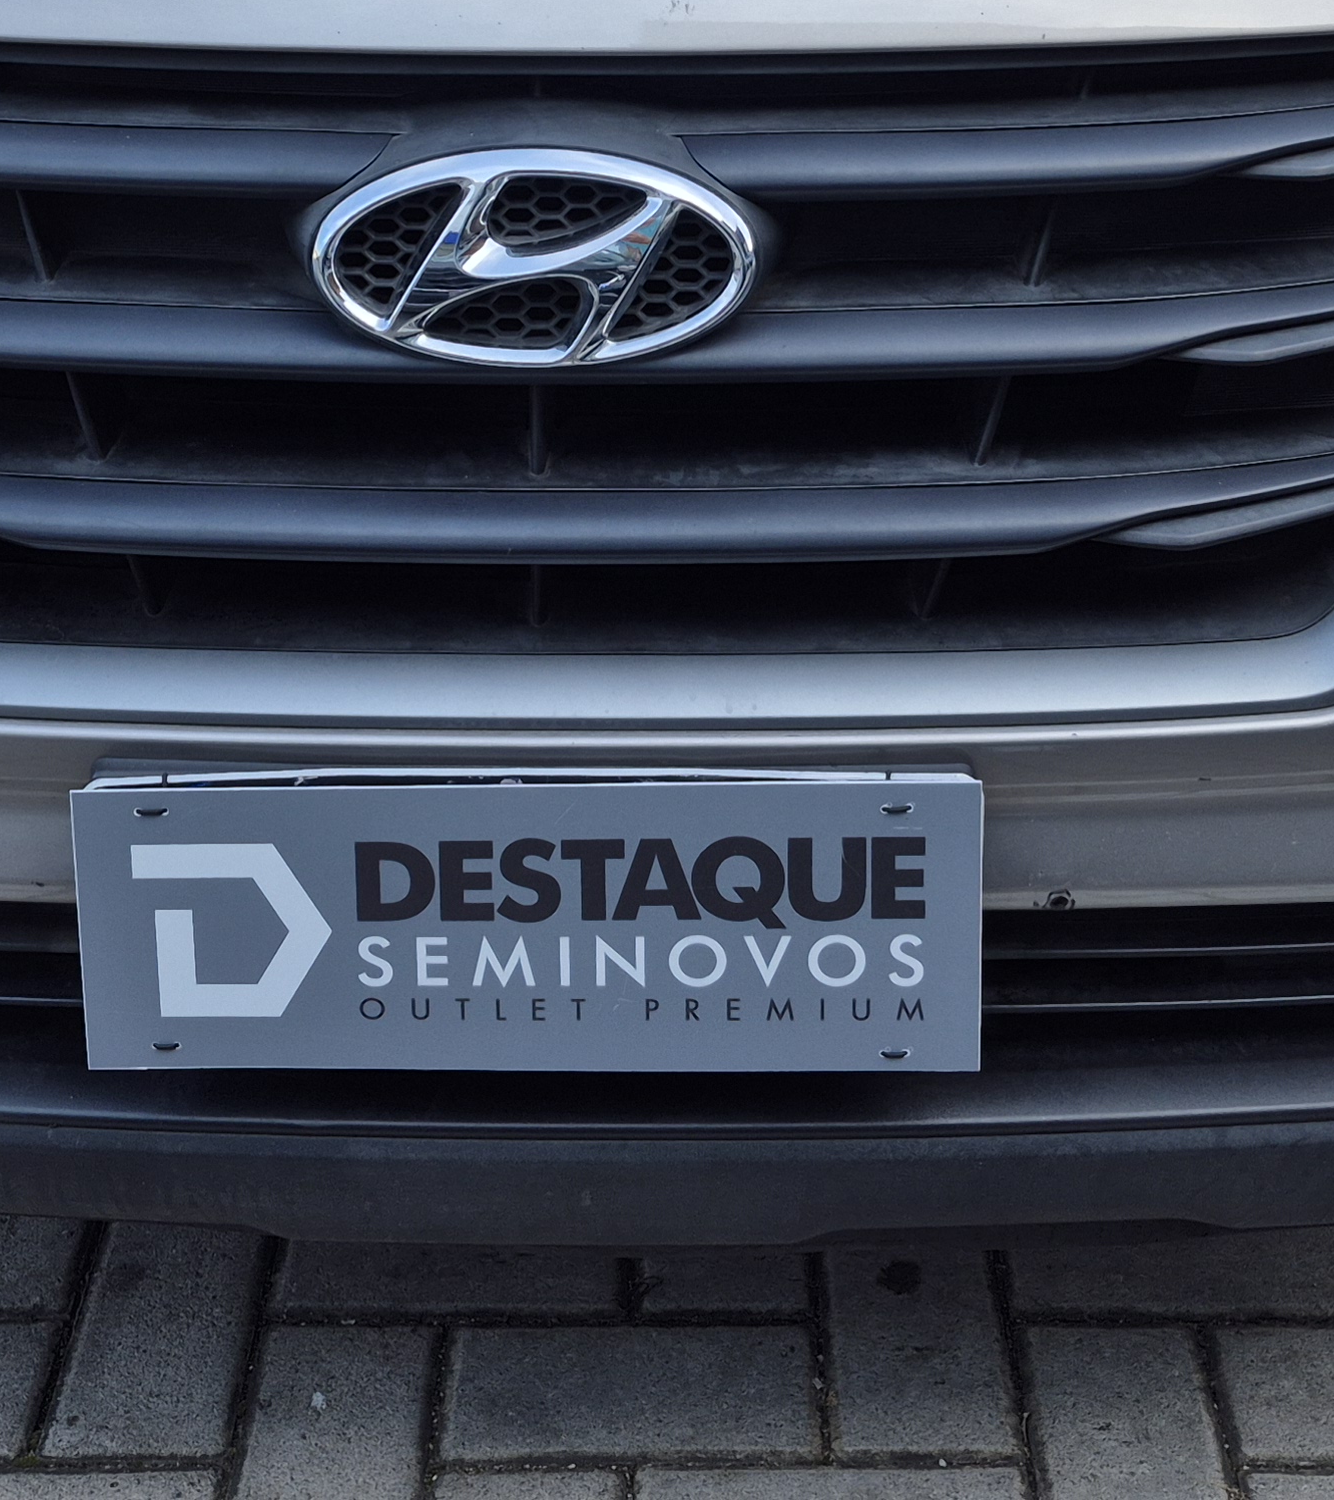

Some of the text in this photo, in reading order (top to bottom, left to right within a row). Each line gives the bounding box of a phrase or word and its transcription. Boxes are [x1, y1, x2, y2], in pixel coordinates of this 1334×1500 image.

[354, 835, 927, 930] DESTAQUE
[357, 933, 926, 988] SEMINOVOS
[359, 997, 926, 1022] OUTLET PREMIUM
